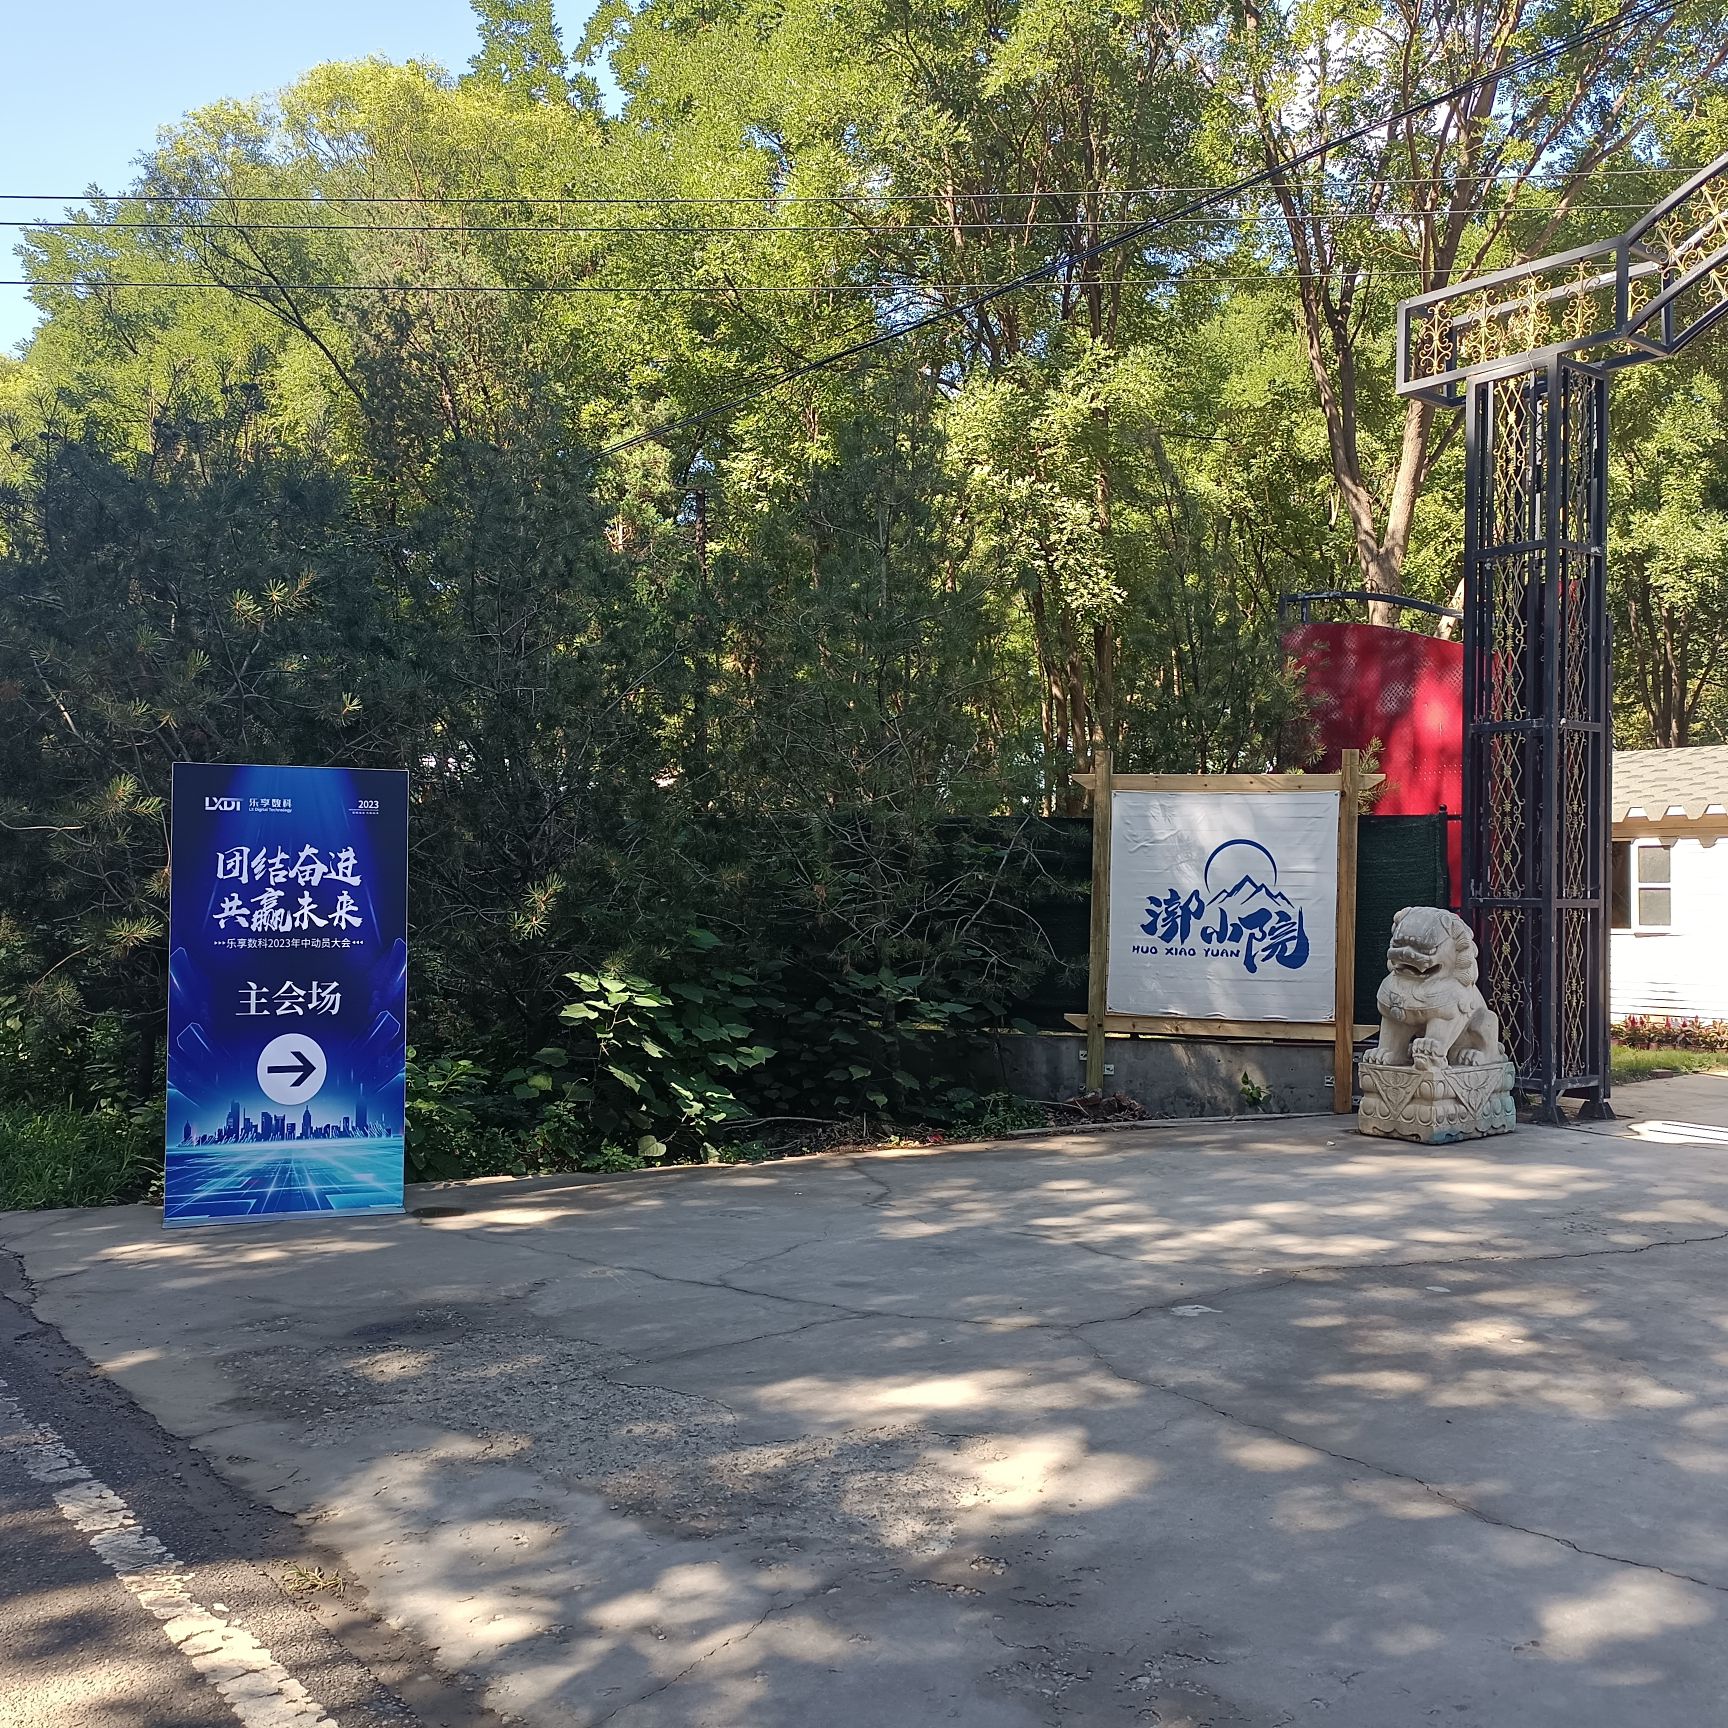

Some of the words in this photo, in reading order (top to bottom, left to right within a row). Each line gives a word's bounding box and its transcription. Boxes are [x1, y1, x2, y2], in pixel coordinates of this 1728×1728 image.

[249, 797, 292, 808] 乐享数科
[358, 800, 379, 809] 2023
[216, 843, 362, 886] 团结奋进
[212, 887, 363, 932] 共赢未来
[226, 938, 351, 949] 乐享数科2023年中动员大会
[1132, 945, 1158, 955] HUO
[1164, 947, 1197, 957] XIAO
[1203, 948, 1241, 958] YUAN
[235, 980, 342, 1016] 主会场
